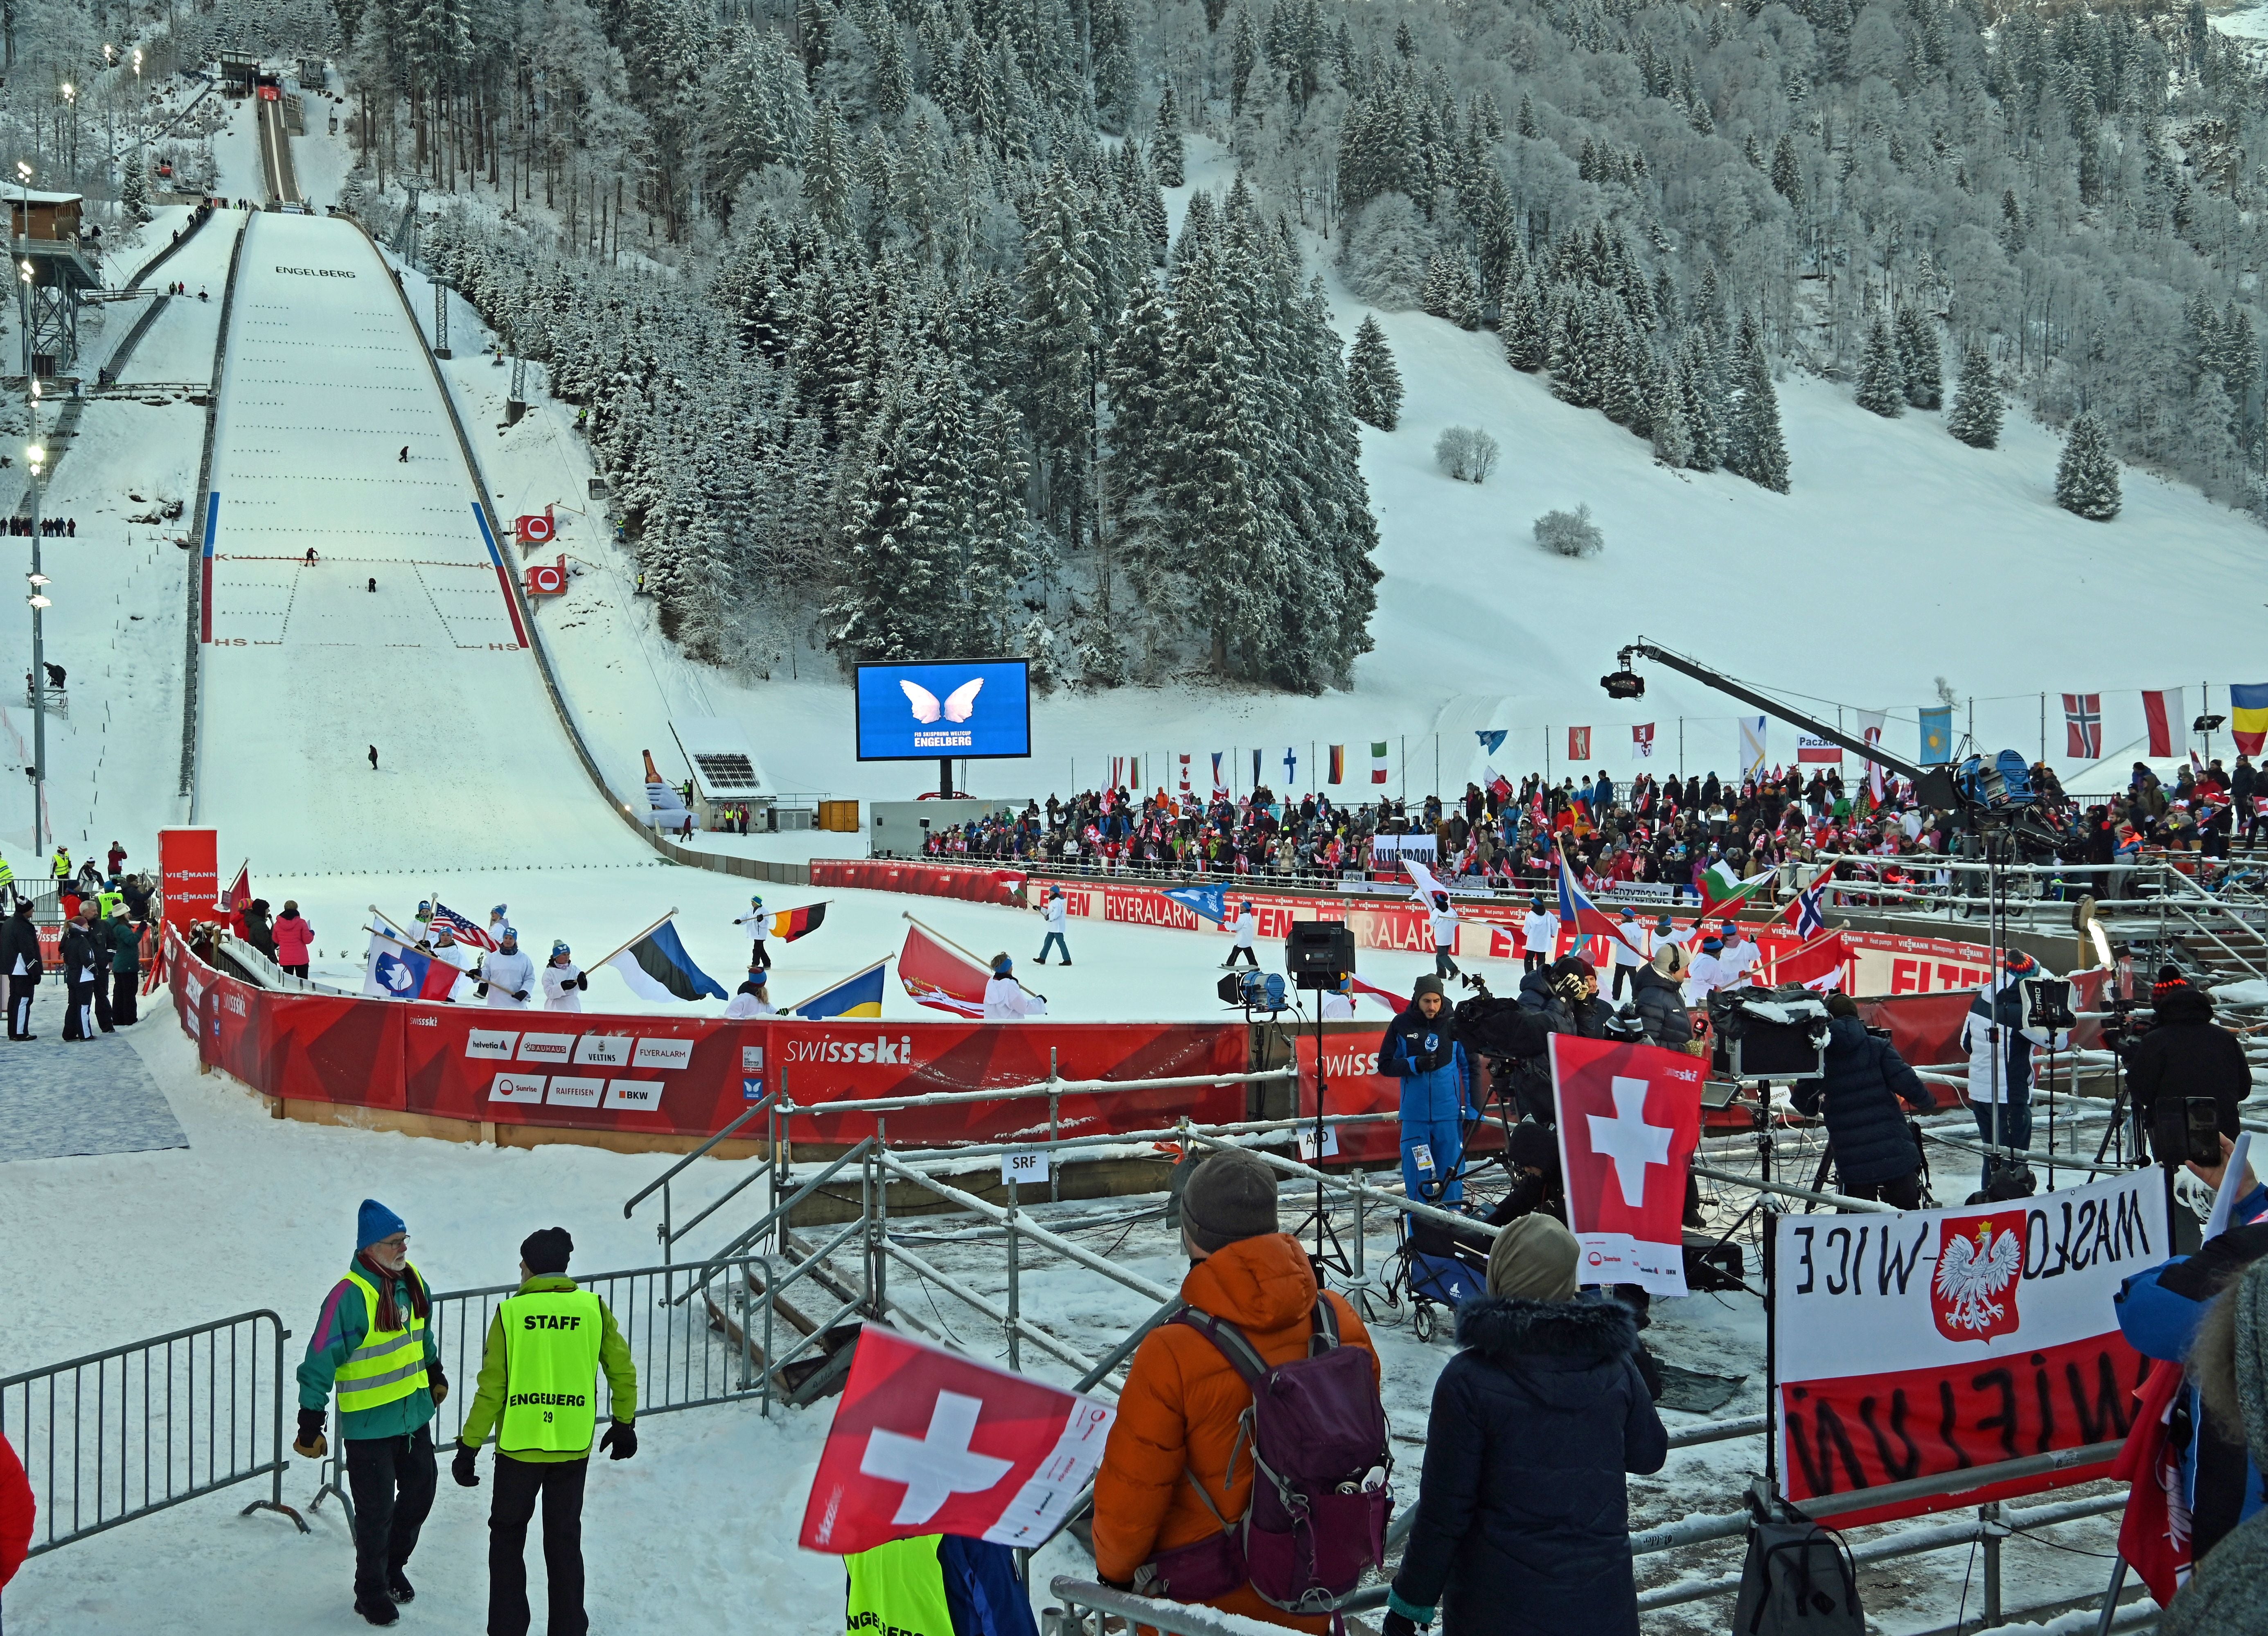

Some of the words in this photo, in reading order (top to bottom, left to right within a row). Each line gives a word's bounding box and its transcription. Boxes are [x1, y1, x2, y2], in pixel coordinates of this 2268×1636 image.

[276, 266, 356, 278] ENGELBERG
[914, 736, 972, 747] ENGELBERG
[166, 870, 216, 881] VIESSMANN
[166, 892, 216, 903] VIESSMANN
[1107, 895, 1195, 928] FLYERALARM
[1315, 900, 1335, 908] VIESSMANN
[1358, 902, 1379, 910] VIESSMANN
[1405, 903, 1427, 913] VIESSMANN
[1455, 906, 1479, 915] VIESSMANN
[1898, 938, 1928, 952] VIESSMANN
[1931, 944, 1955, 954] Wärmepumpen
[1959, 946, 1983, 960] VIESSMANN
[223, 988, 246, 1018] swissski
[410, 1015, 438, 1027] swissski
[473, 1040, 498, 1049] helvetia
[531, 1044, 566, 1054] BAUHAUS
[784, 1034, 911, 1064] swissski
[588, 1053, 616, 1062] VELTINS
[640, 1049, 686, 1058] FLYERALARM
[556, 1087, 594, 1096] RAIFFEISEN
[627, 1091, 648, 1100] BKW
[1012, 1155, 1037, 1169] SRF
[524, 1315, 581, 1330] STAFF
[510, 1392, 585, 1407] ENGELBERG
[543, 1410, 553, 1424] 29
